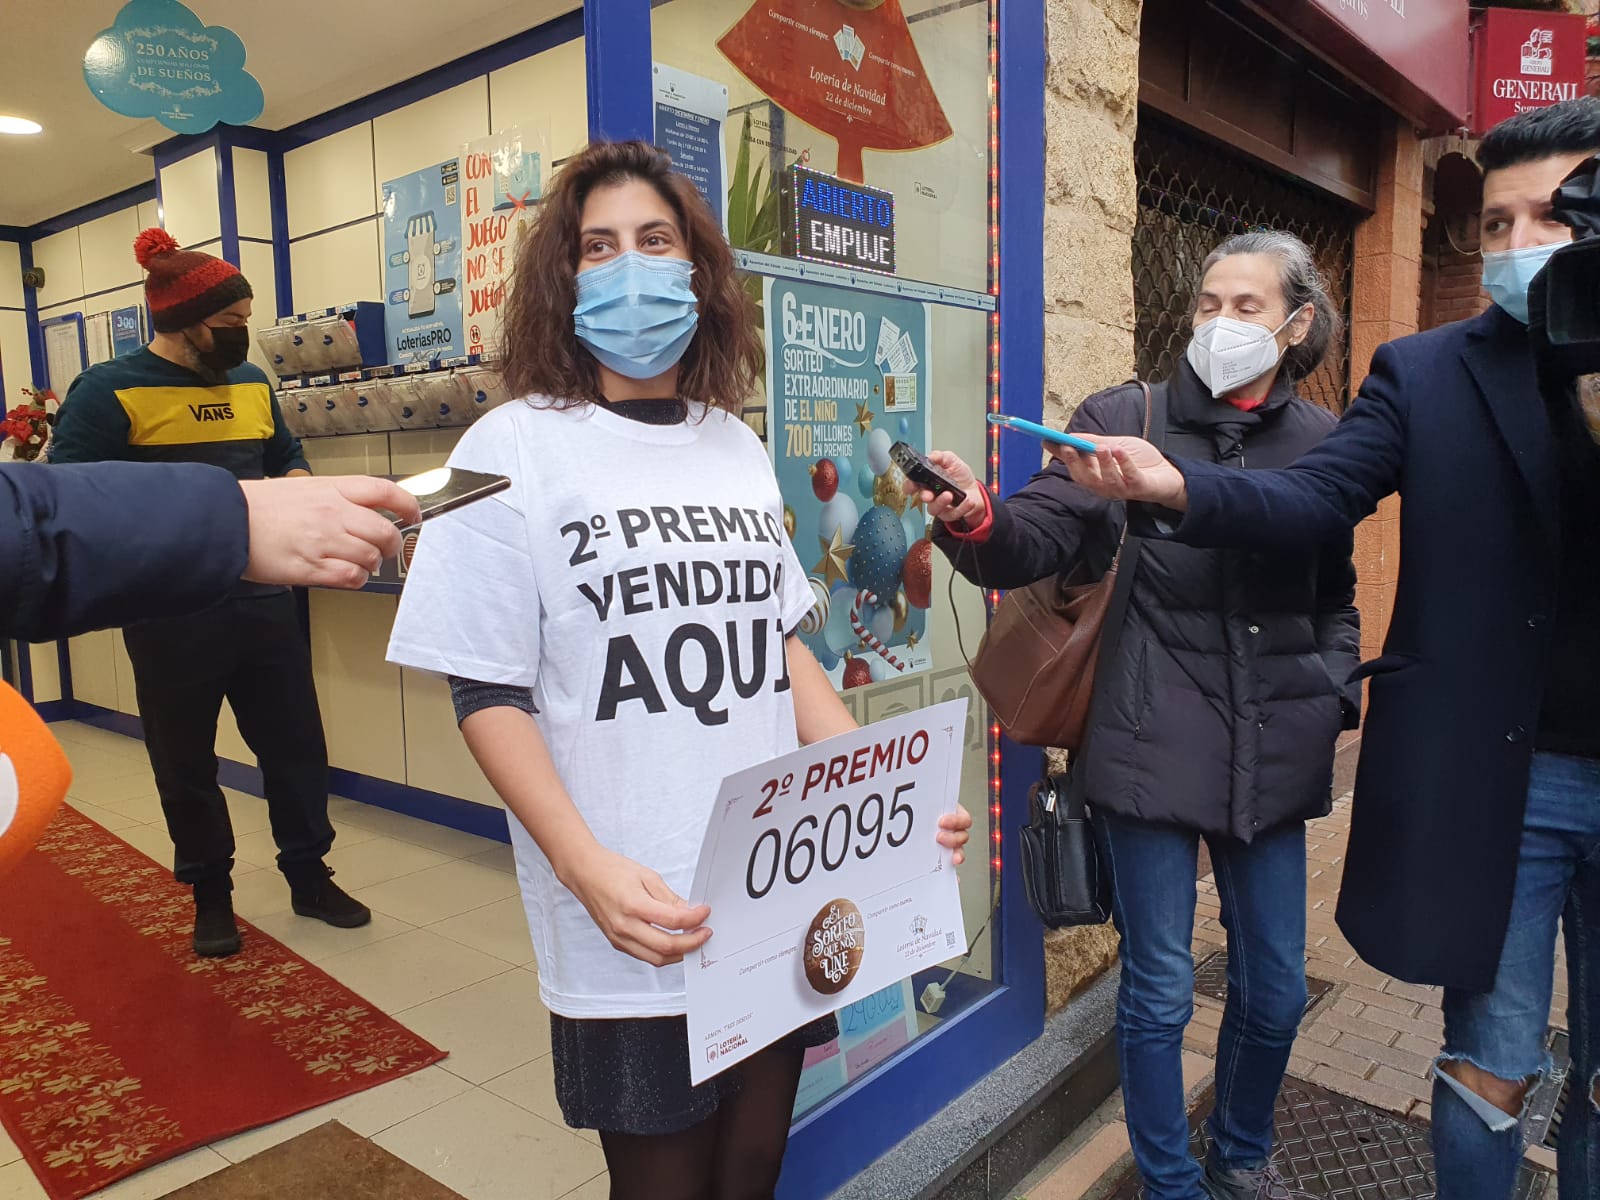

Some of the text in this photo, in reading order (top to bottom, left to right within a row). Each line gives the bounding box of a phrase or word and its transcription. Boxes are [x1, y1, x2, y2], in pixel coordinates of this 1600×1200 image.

[136, 43, 209, 60] 250 AÑOS
[137, 66, 211, 82] DE SUEÑOS
[809, 66, 887, 106] Lotería de Navidad
[826, 92, 873, 116] 22 de diciembre
[1493, 79, 1578, 101] GENERALI
[466, 152, 492, 179] CON
[466, 187, 480, 217] EL
[801, 179, 891, 228] ABIERTO
[467, 215, 507, 251] JUEGO
[810, 219, 890, 265] EMPUJE
[467, 246, 506, 284] NO SE
[782, 291, 797, 343] 6
[801, 304, 866, 352] ENERO
[784, 349, 823, 373] SORTEO
[784, 374, 869, 399] EXTRAORDINARIO
[189, 403, 235, 422] VANS
[785, 399, 837, 421] DE EL NIÑO
[784, 424, 812, 457] 700
[813, 425, 852, 442] MILLONES
[813, 443, 853, 457] EN PREMIOS
[560, 505, 782, 567] 2º PREMIO
[752, 729, 929, 819] 2º PREMIO
[746, 781, 915, 899] 06095
[813, 912, 855, 957] SORTEO
[824, 932, 855, 958] QUE NOS
[820, 951, 849, 983] UNE
[720, 1038, 748, 1056] NACIONAL
